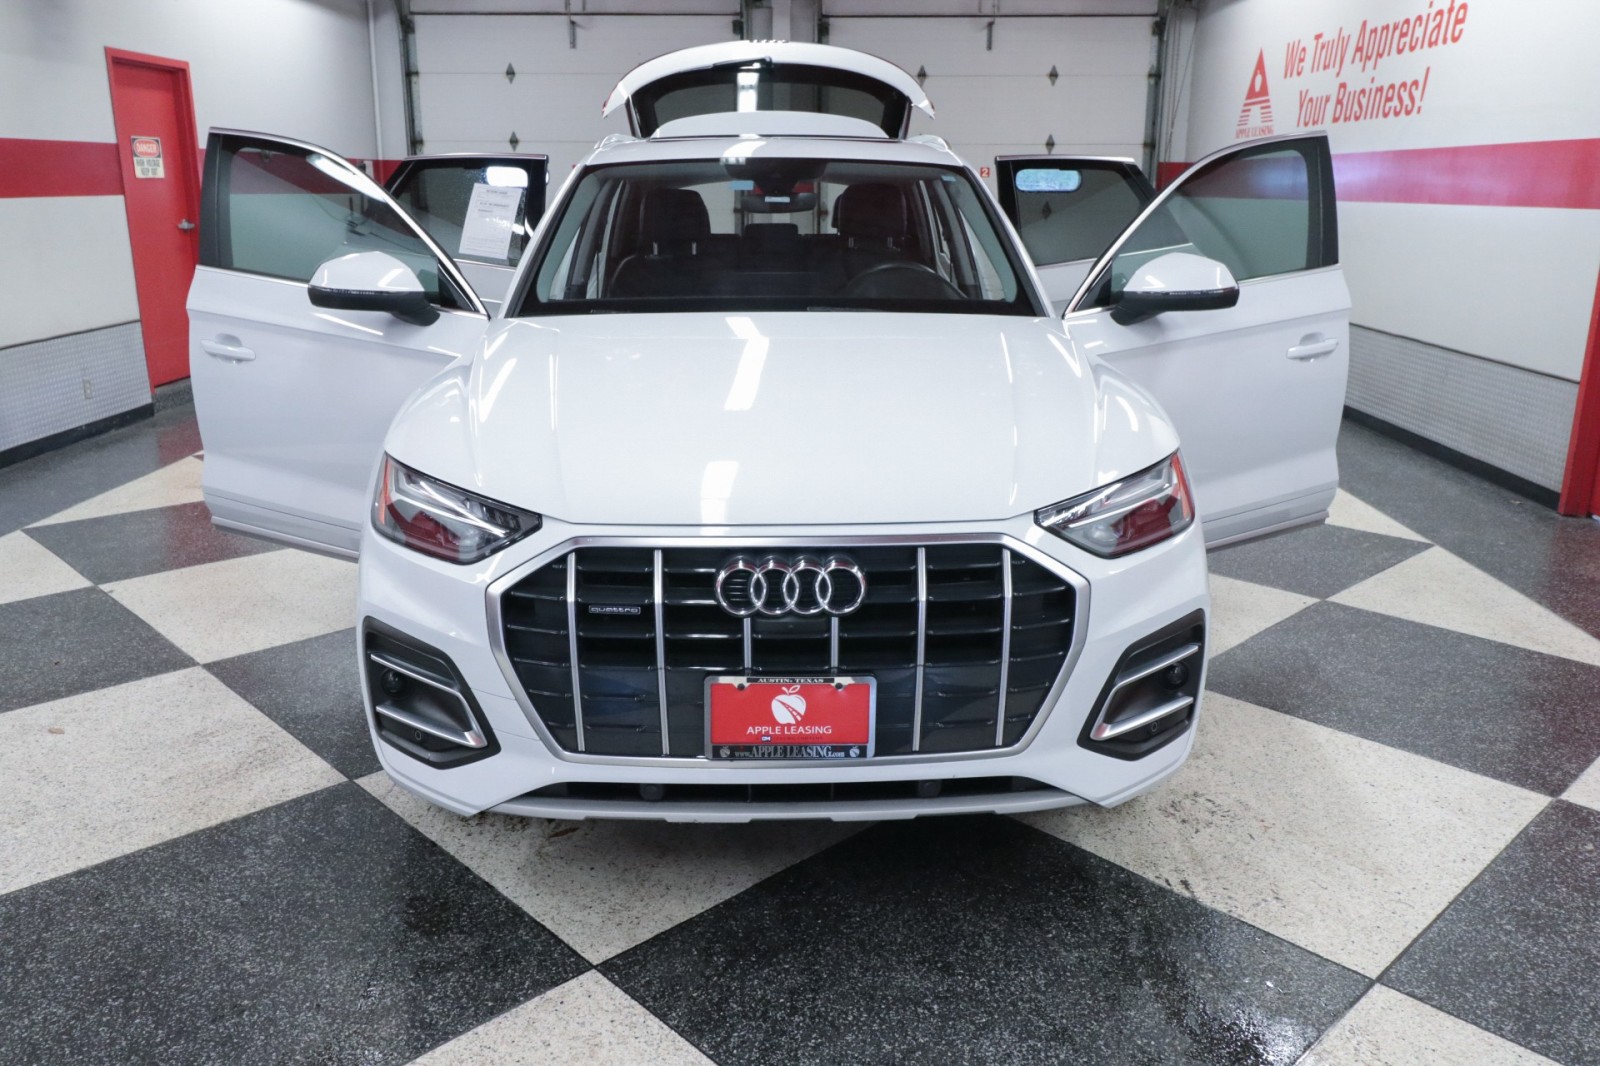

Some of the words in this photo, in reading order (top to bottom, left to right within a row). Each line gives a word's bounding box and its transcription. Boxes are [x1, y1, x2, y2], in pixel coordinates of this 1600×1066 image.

[1283, 39, 1307, 80] We
[1310, 26, 1351, 78] Truly
[1350, 0, 1469, 73] Appreciate
[1296, 88, 1332, 128] Your
[1331, 66, 1431, 125] Business!
[136, 142, 157, 153] DANGER
[981, 168, 989, 177] 2
[746, 726, 782, 735] APPLE
[784, 725, 832, 734] LEASING
